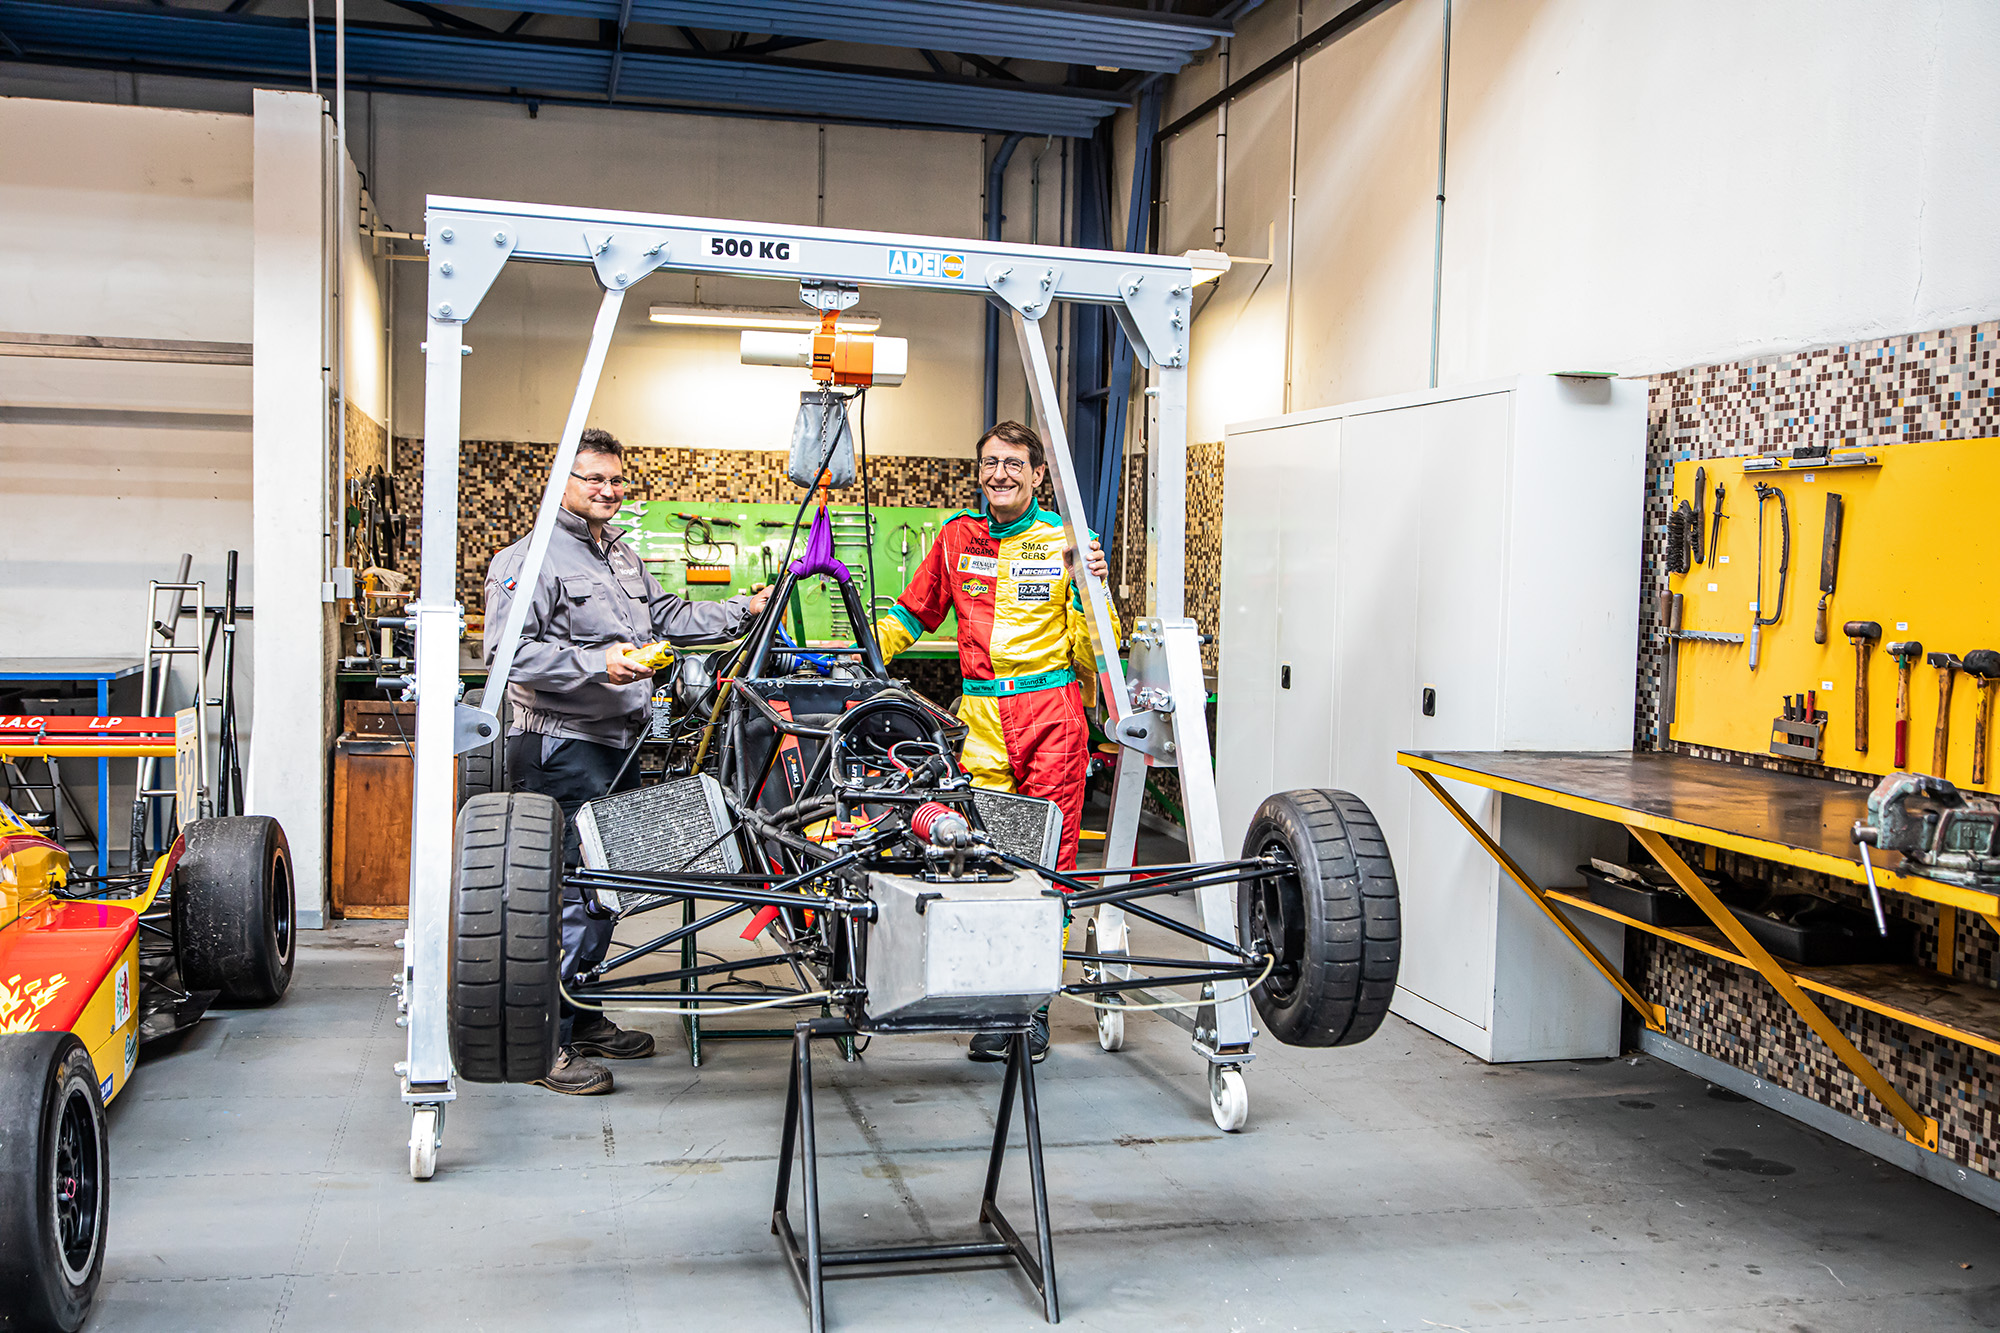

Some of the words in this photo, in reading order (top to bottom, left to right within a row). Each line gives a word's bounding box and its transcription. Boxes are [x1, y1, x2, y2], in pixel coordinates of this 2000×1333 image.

[711, 237, 753, 258] 500
[759, 241, 790, 261] KG
[889, 250, 941, 277] ADEI
[964, 546, 995, 556] NOGARO
[1021, 541, 1049, 551] SMAC
[1021, 551, 1046, 560] GERS
[88, 717, 123, 729] L.P
[179, 748, 196, 825] 32
